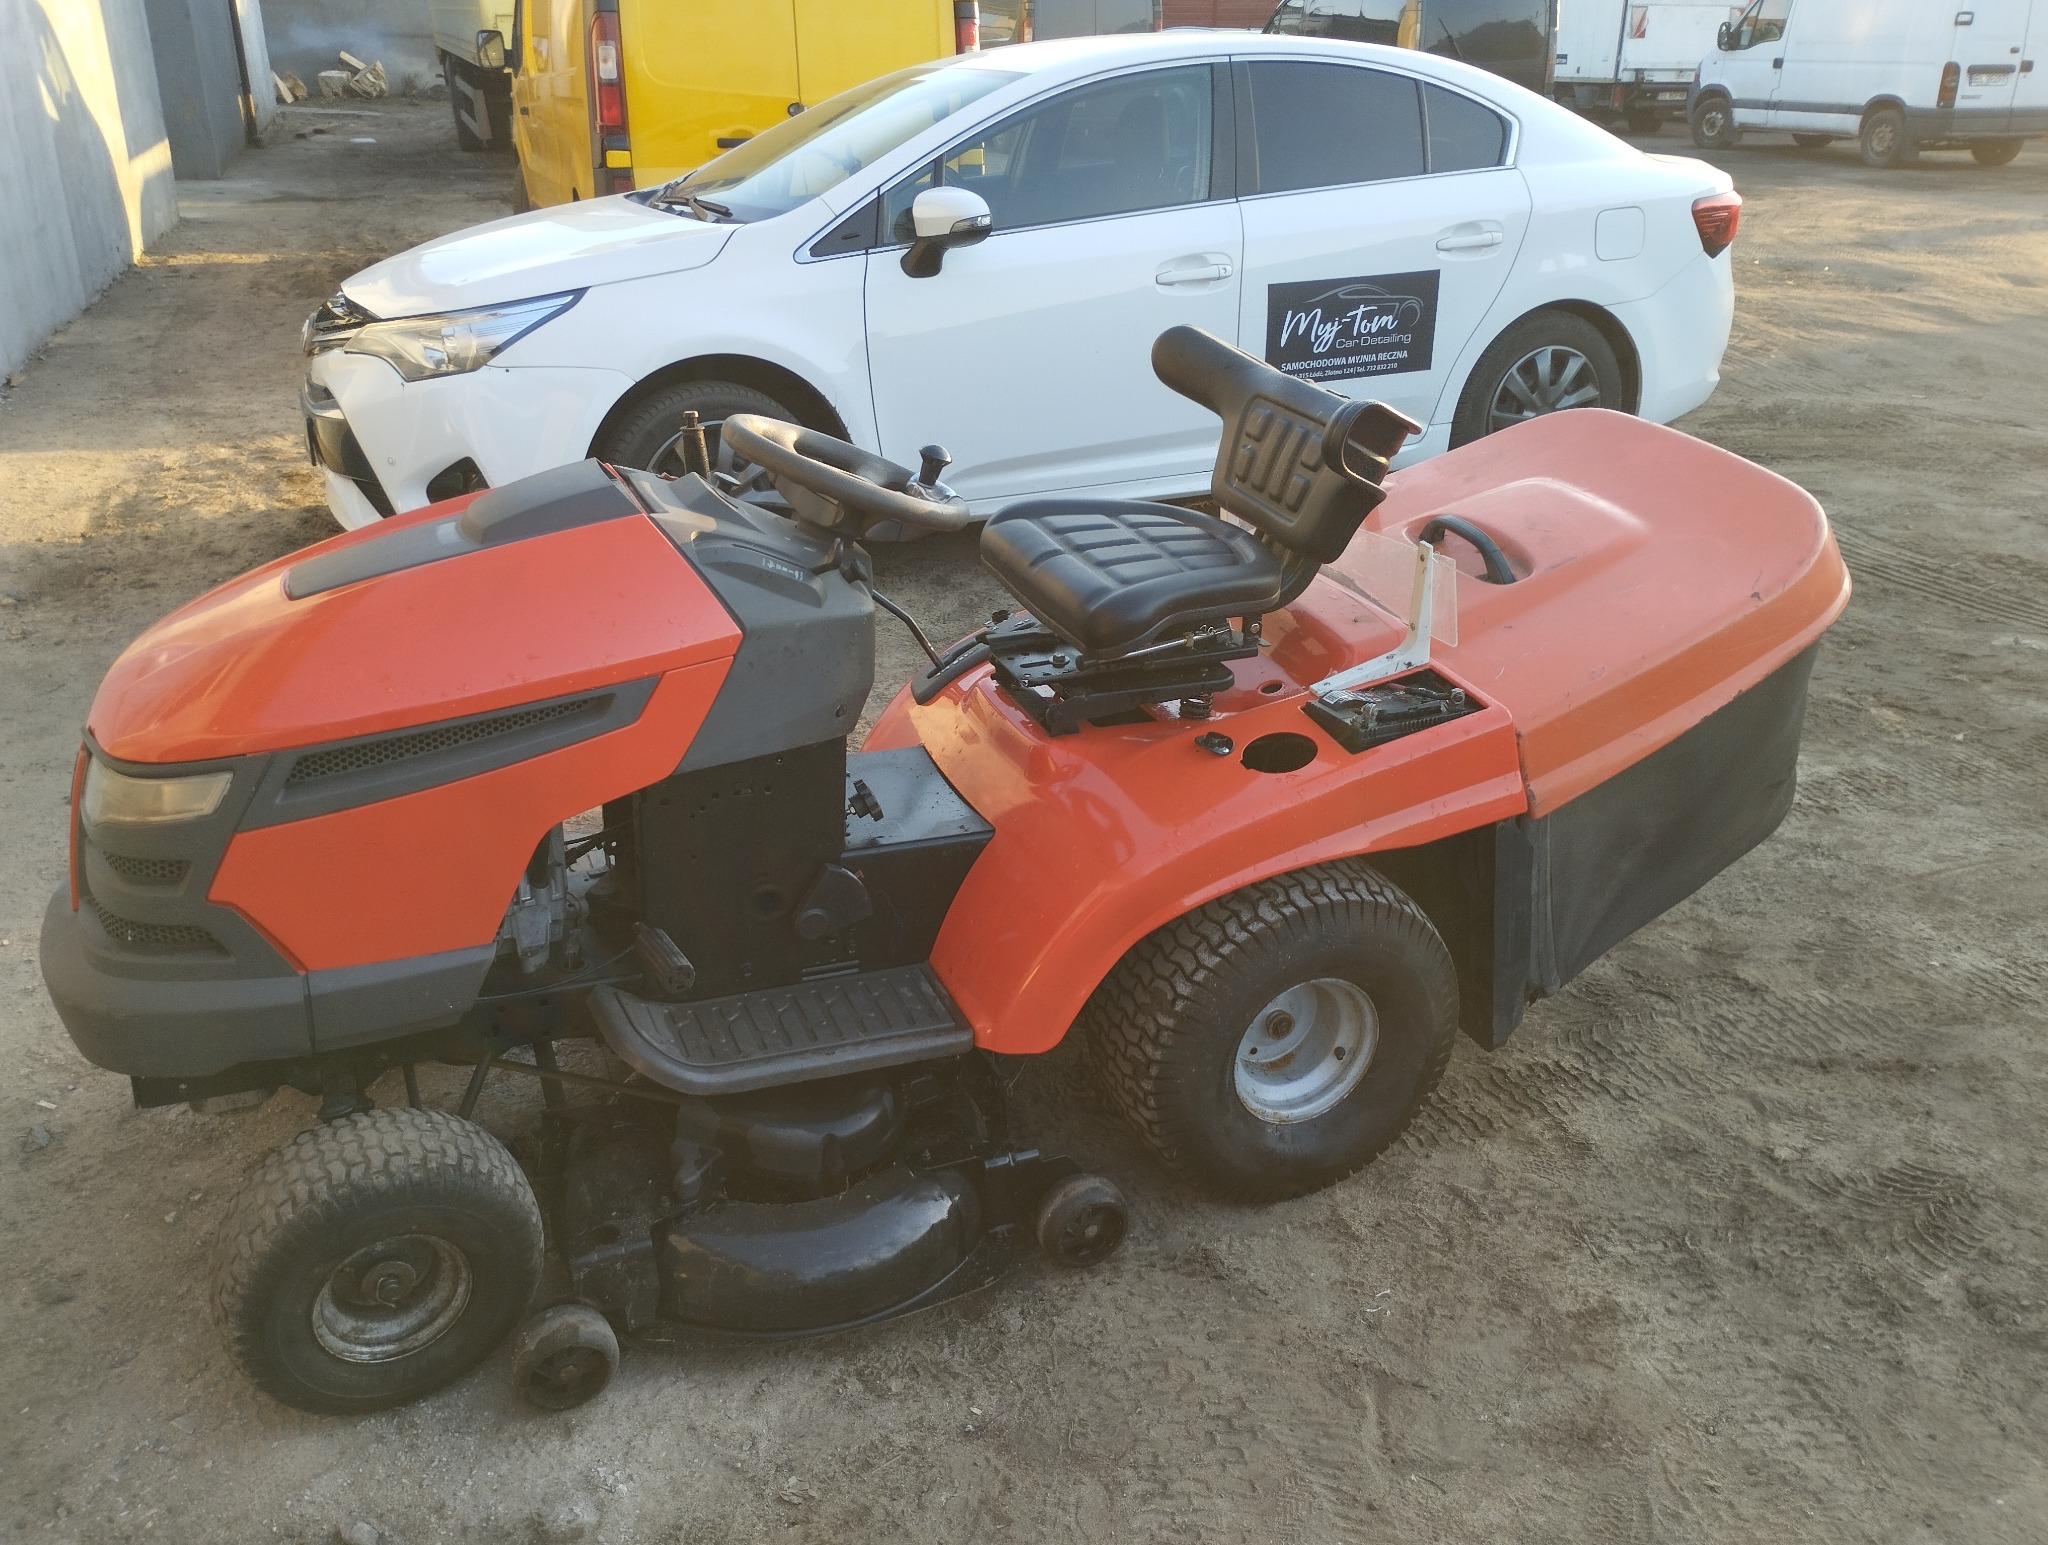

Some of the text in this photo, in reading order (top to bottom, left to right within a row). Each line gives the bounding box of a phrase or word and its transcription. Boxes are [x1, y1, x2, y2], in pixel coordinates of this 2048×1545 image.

[1280, 305, 1398, 353] Myj-Tom
[1336, 333, 1411, 349] Car Detailing
[1280, 357, 1346, 372] SAMOCHODOWA
[1347, 353, 1376, 365] MYJNIA
